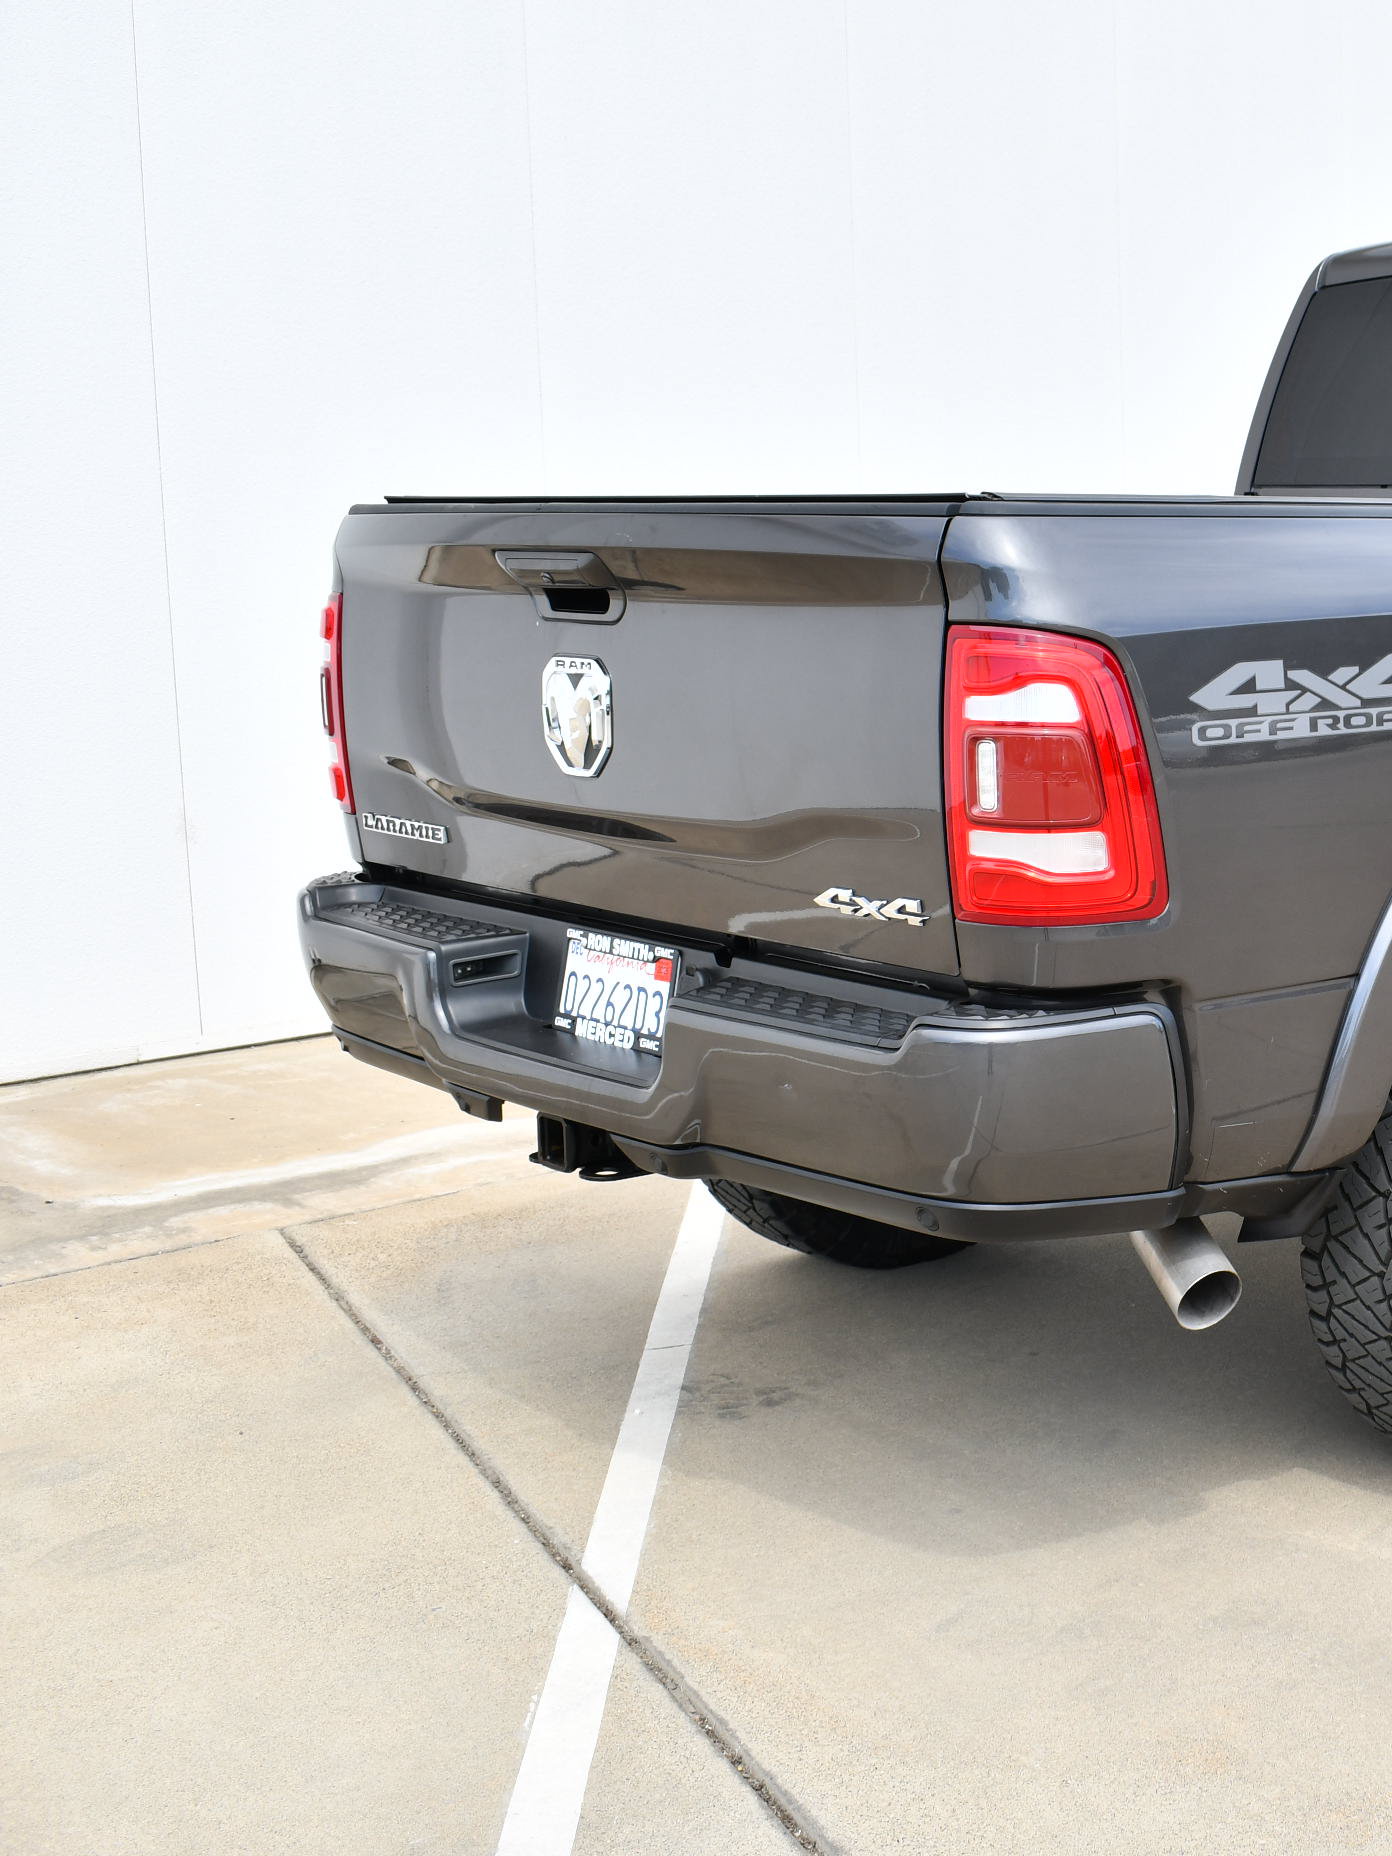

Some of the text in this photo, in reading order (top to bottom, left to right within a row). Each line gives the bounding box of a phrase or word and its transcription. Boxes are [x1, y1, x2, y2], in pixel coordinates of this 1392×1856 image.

[555, 659, 592, 671] RAM
[1197, 717, 1299, 743] OFF
[362, 812, 449, 844] LARAMIE
[587, 933, 612, 953] RON
[612, 938, 650, 961] SMITH
[654, 946, 676, 960] GMC
[564, 971, 664, 1036] 02262D3
[554, 1016, 660, 1051] GMC MERCED GMC
